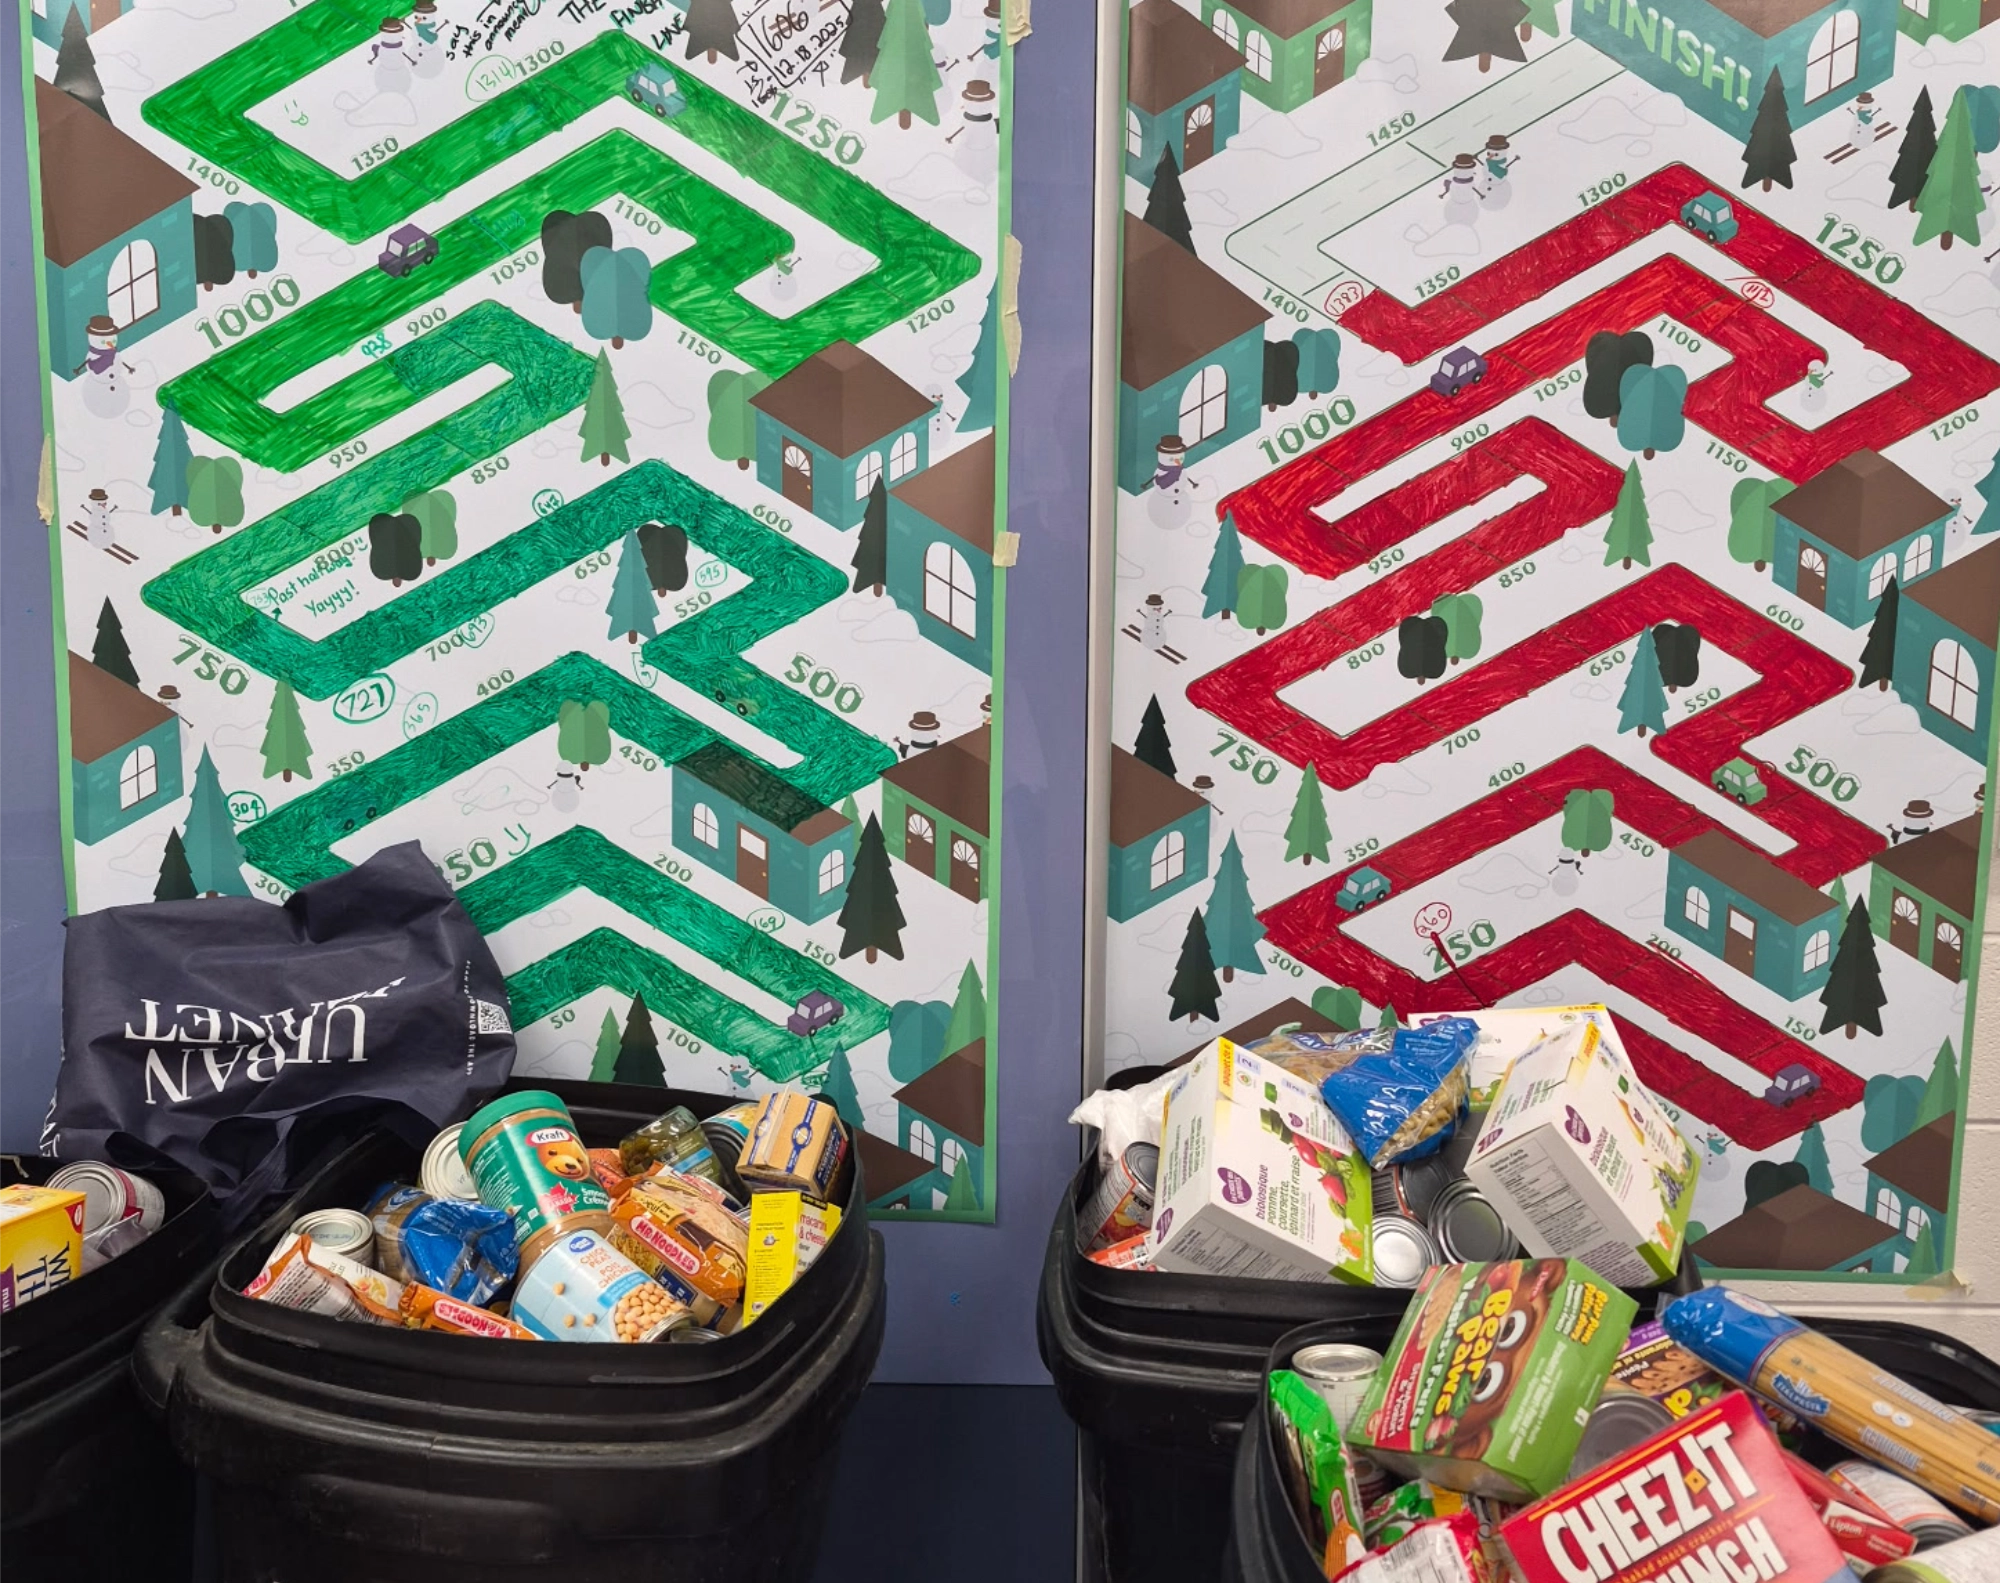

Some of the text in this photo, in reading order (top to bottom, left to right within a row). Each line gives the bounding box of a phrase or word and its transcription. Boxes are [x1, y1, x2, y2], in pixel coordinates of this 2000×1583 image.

[446, 25, 469, 61] say
[515, 40, 565, 76] 1300
[1584, 0, 1752, 111] INISH!
[769, 90, 866, 164] 1250
[1365, 111, 1416, 147] 1450
[350, 137, 399, 172] 1350
[186, 156, 240, 196] 1400
[1577, 172, 1627, 207] 1300
[615, 199, 662, 236] 1100
[1815, 212, 1905, 284] 1250
[490, 250, 540, 285] 1050
[1414, 265, 1461, 299] 1350
[195, 274, 301, 348] 1000
[905, 298, 956, 334] 1200
[1261, 287, 1310, 323] 1400
[407, 306, 448, 337] 900
[1658, 319, 1702, 354] 1100
[677, 329, 722, 365] 1150
[1532, 368, 1583, 403] 1050
[1257, 395, 1356, 465] 1000
[1450, 422, 1490, 451] 900
[1929, 407, 1980, 442] 1200
[329, 440, 368, 469] 950
[1705, 440, 1748, 474] 1150
[471, 456, 511, 485] 850
[752, 503, 793, 534] 600
[314, 541, 355, 572] 800
[574, 552, 612, 580] 650
[1368, 547, 1405, 575] 950
[1498, 560, 1537, 588] 850
[267, 580, 299, 606] Past
[674, 591, 712, 619] 550
[1765, 603, 1804, 631] 600
[425, 632, 463, 661] 700
[1347, 643, 1386, 670] 800
[171, 635, 250, 695] 750
[1589, 649, 1627, 677] 650
[476, 669, 516, 698] 400
[784, 652, 864, 714] 500
[1685, 687, 1722, 713] 550
[1208, 728, 1281, 785] 750
[1442, 728, 1481, 756] 700
[327, 750, 366, 779] 350
[619, 745, 657, 771] 450
[1785, 744, 1862, 802] 500
[1487, 761, 1526, 790] 400
[1344, 837, 1380, 863] 350
[1619, 831, 1655, 858] 450
[654, 852, 693, 883] 200
[254, 874, 293, 902] 300
[803, 939, 836, 966] 150
[1424, 919, 1497, 973] 250
[1267, 950, 1304, 978] 300
[551, 1009, 576, 1030] 50
[1784, 1015, 1817, 1042] 150
[667, 1027, 702, 1055] 100
[536, 1130, 566, 1142] Kraft
[650, 1230, 697, 1273] NOODLES
[1467, 1288, 1514, 1382] Bear
[1830, 1517, 1864, 1536] Lipton
[1621, 1518, 1735, 1583] baked snack crackers
